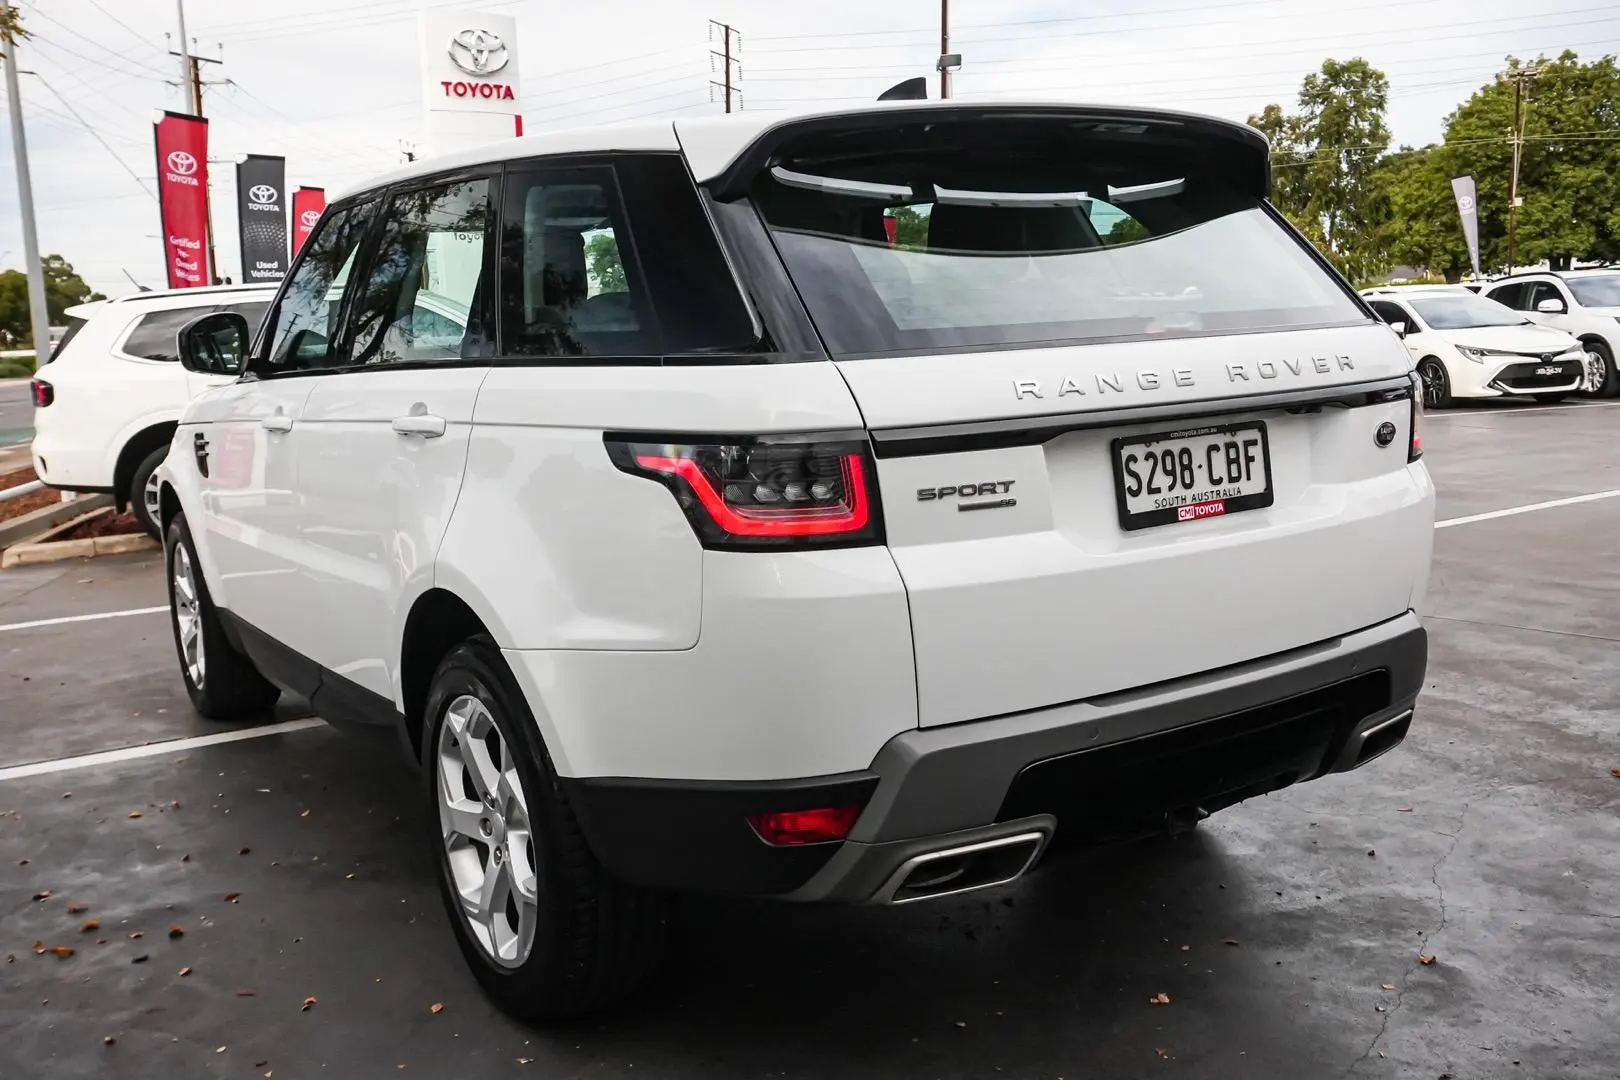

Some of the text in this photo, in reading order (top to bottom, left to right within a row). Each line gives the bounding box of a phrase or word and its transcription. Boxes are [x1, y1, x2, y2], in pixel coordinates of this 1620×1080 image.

[441, 81, 514, 100] TOYOTA
[166, 172, 199, 186] TOYOTA
[248, 203, 280, 212] TOYOTA
[256, 261, 279, 269] Used
[251, 269, 284, 278] Vehicles
[1013, 354, 1355, 400] RANGE ROVER
[1170, 427, 1218, 438] cmitoyota.com.au
[917, 480, 1016, 501] SPORT
[1154, 486, 1242, 508] SOUTH AUSTRALIA
[1179, 502, 1224, 518] CMI TOYOTA
